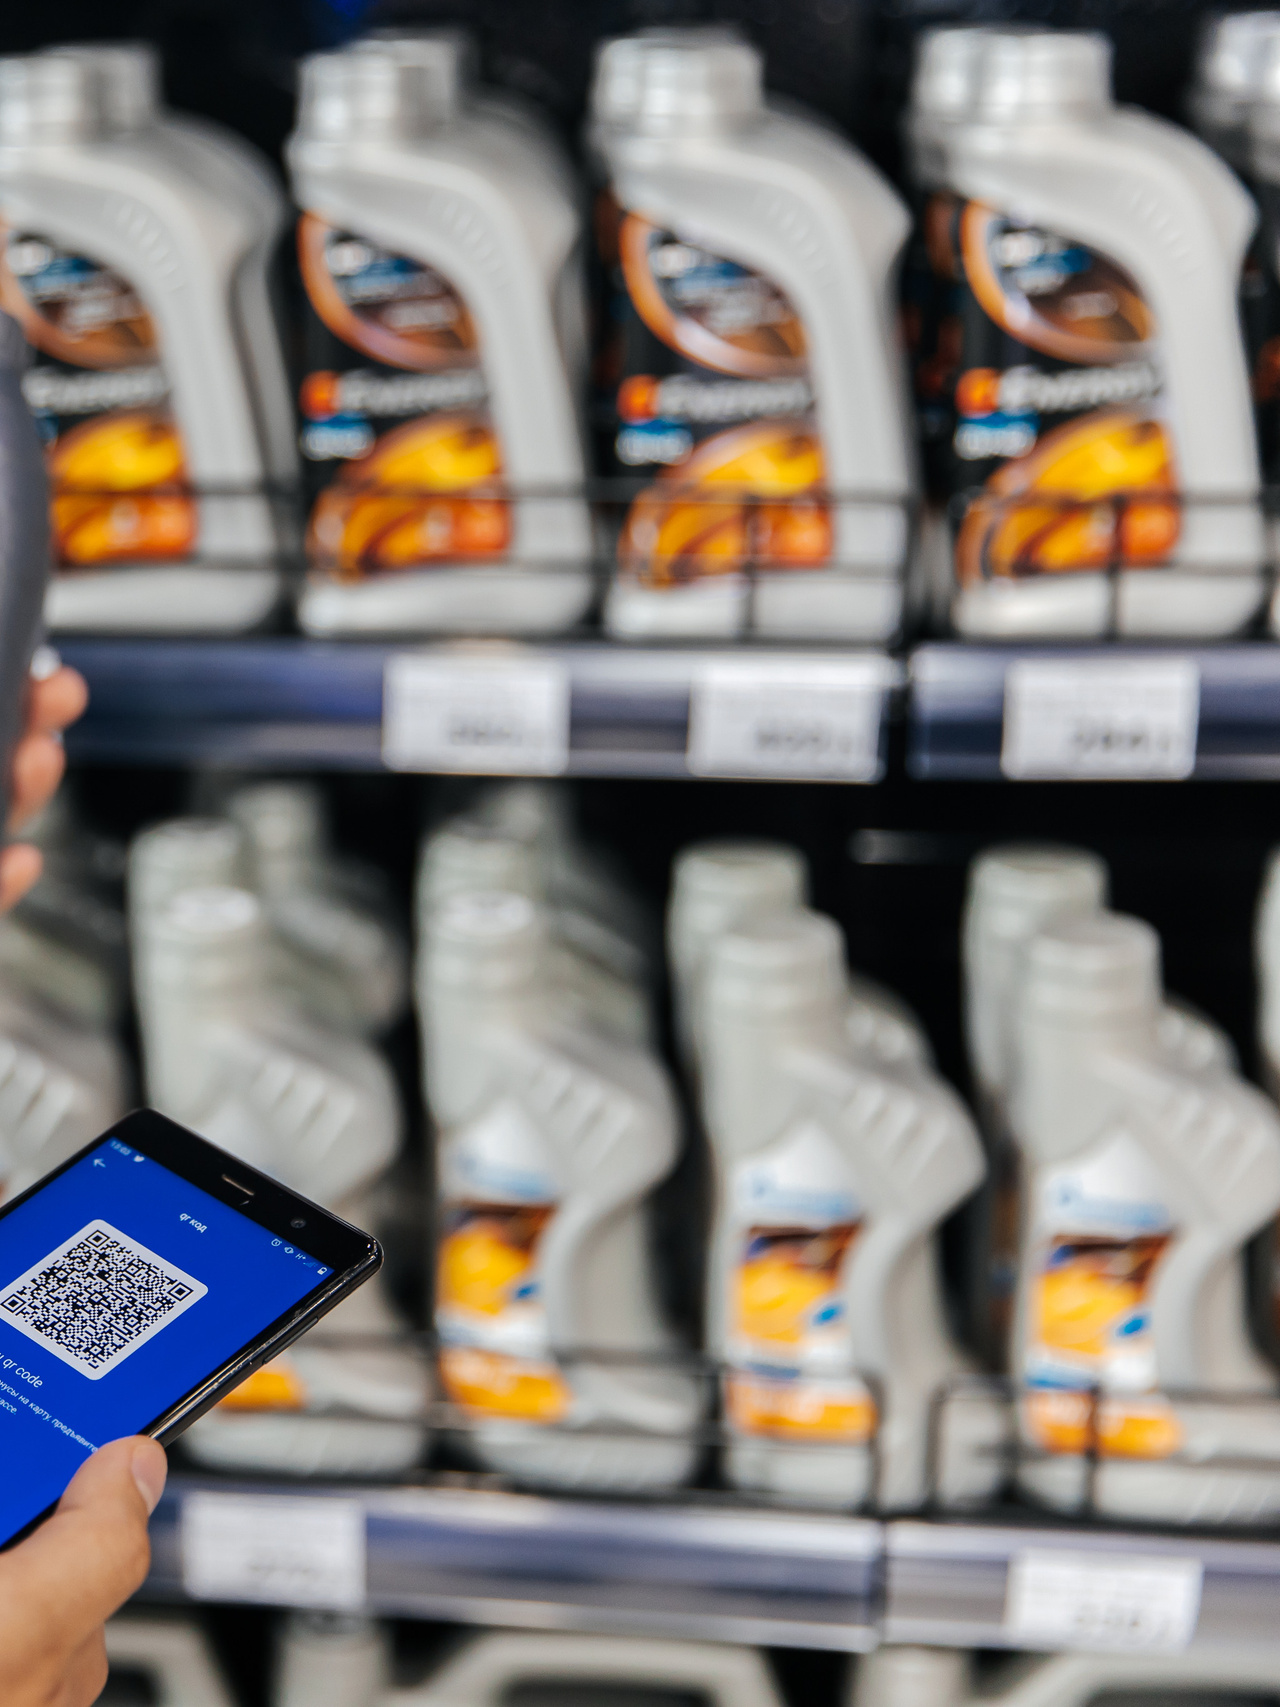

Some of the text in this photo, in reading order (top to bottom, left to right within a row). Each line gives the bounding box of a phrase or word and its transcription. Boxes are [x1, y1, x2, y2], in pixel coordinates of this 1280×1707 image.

[179, 1212, 207, 1233] qr код
[3, 1358, 18, 1369] qr
[16, 1367, 43, 1388] code
[19, 1395, 30, 1405] на
